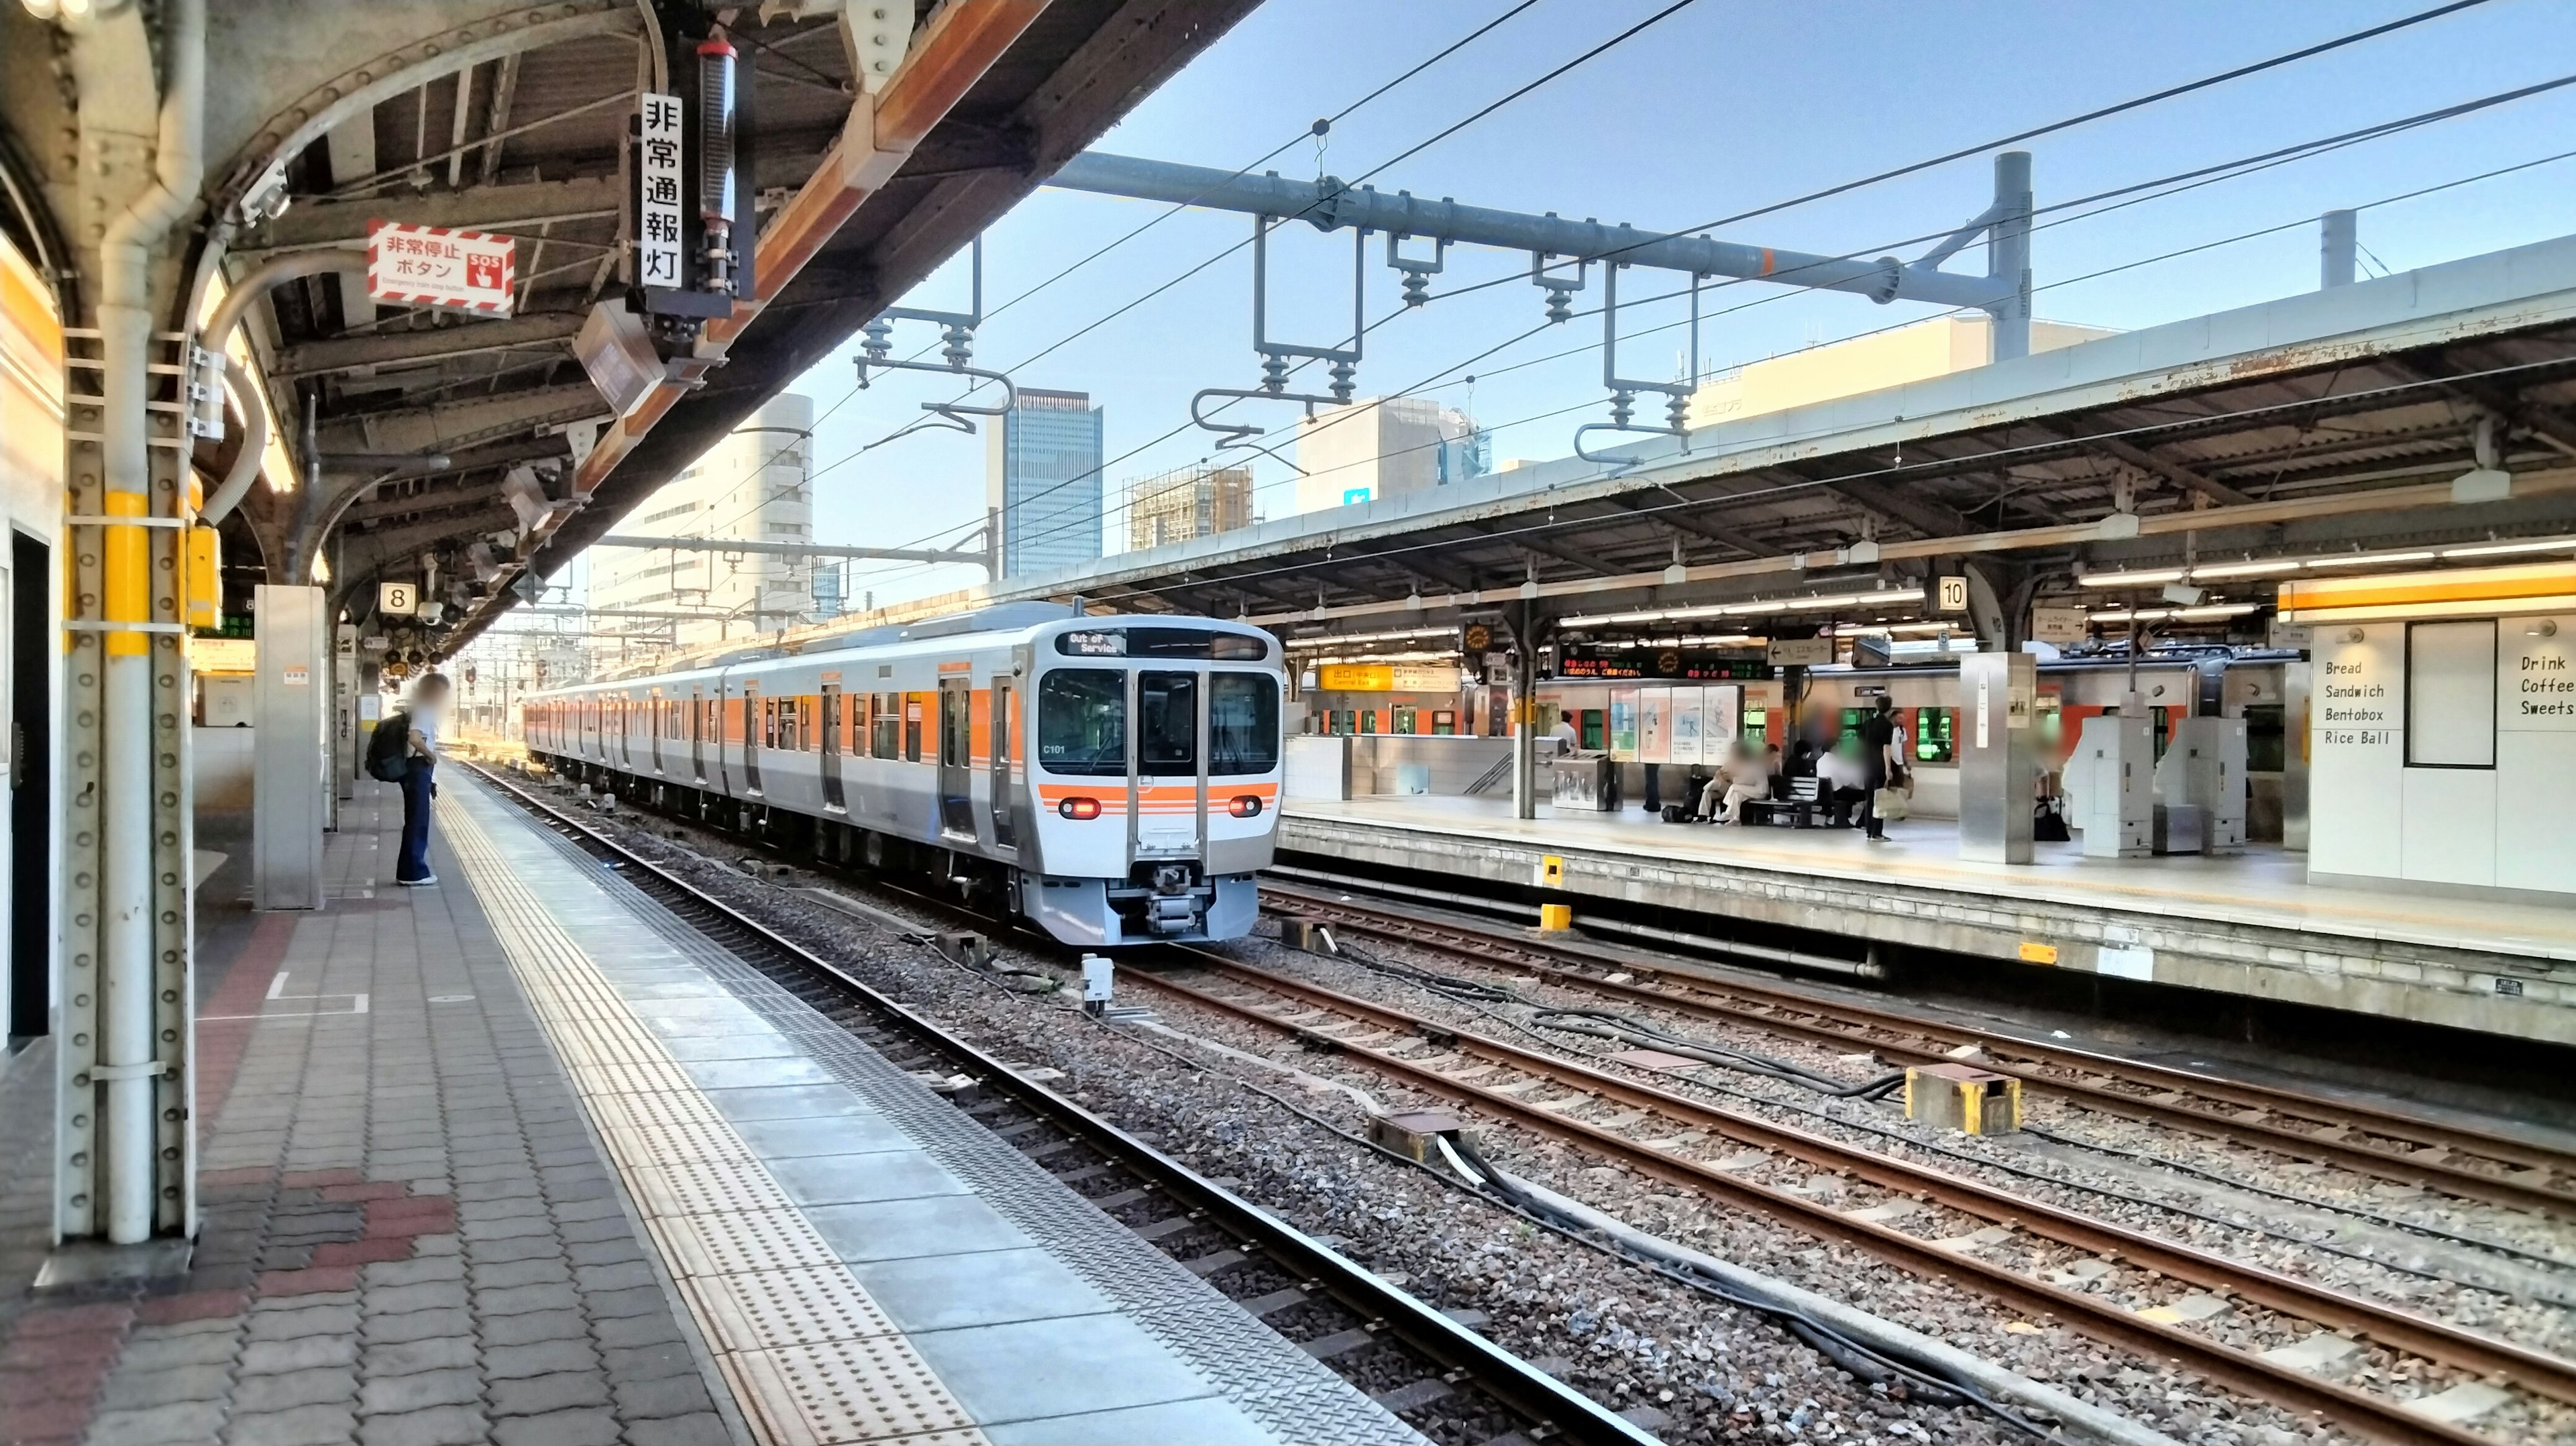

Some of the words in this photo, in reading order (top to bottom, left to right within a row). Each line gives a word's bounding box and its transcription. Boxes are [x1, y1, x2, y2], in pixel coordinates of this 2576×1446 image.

[646, 101, 678, 280] 非常通報灯
[387, 236, 461, 260] 非常停止
[397, 259, 451, 278] ボタン
[470, 254, 500, 268] SOS
[390, 589, 405, 608] 8
[1945, 583, 1962, 604] 10
[1070, 634, 1088, 644] Out
[1091, 633, 1104, 643] of
[1081, 644, 1118, 654] Service
[2326, 661, 2362, 675] Bread
[2522, 656, 2566, 671] Drink
[2326, 683, 2385, 698] Sandwich
[2522, 677, 2575, 693] Coffee
[2325, 708, 2383, 721] Bentobox
[2521, 701, 2575, 716] Sweets
[2325, 730, 2354, 744] Rice
[2361, 730, 2390, 744] Ball
[1044, 745, 1065, 754] C101
